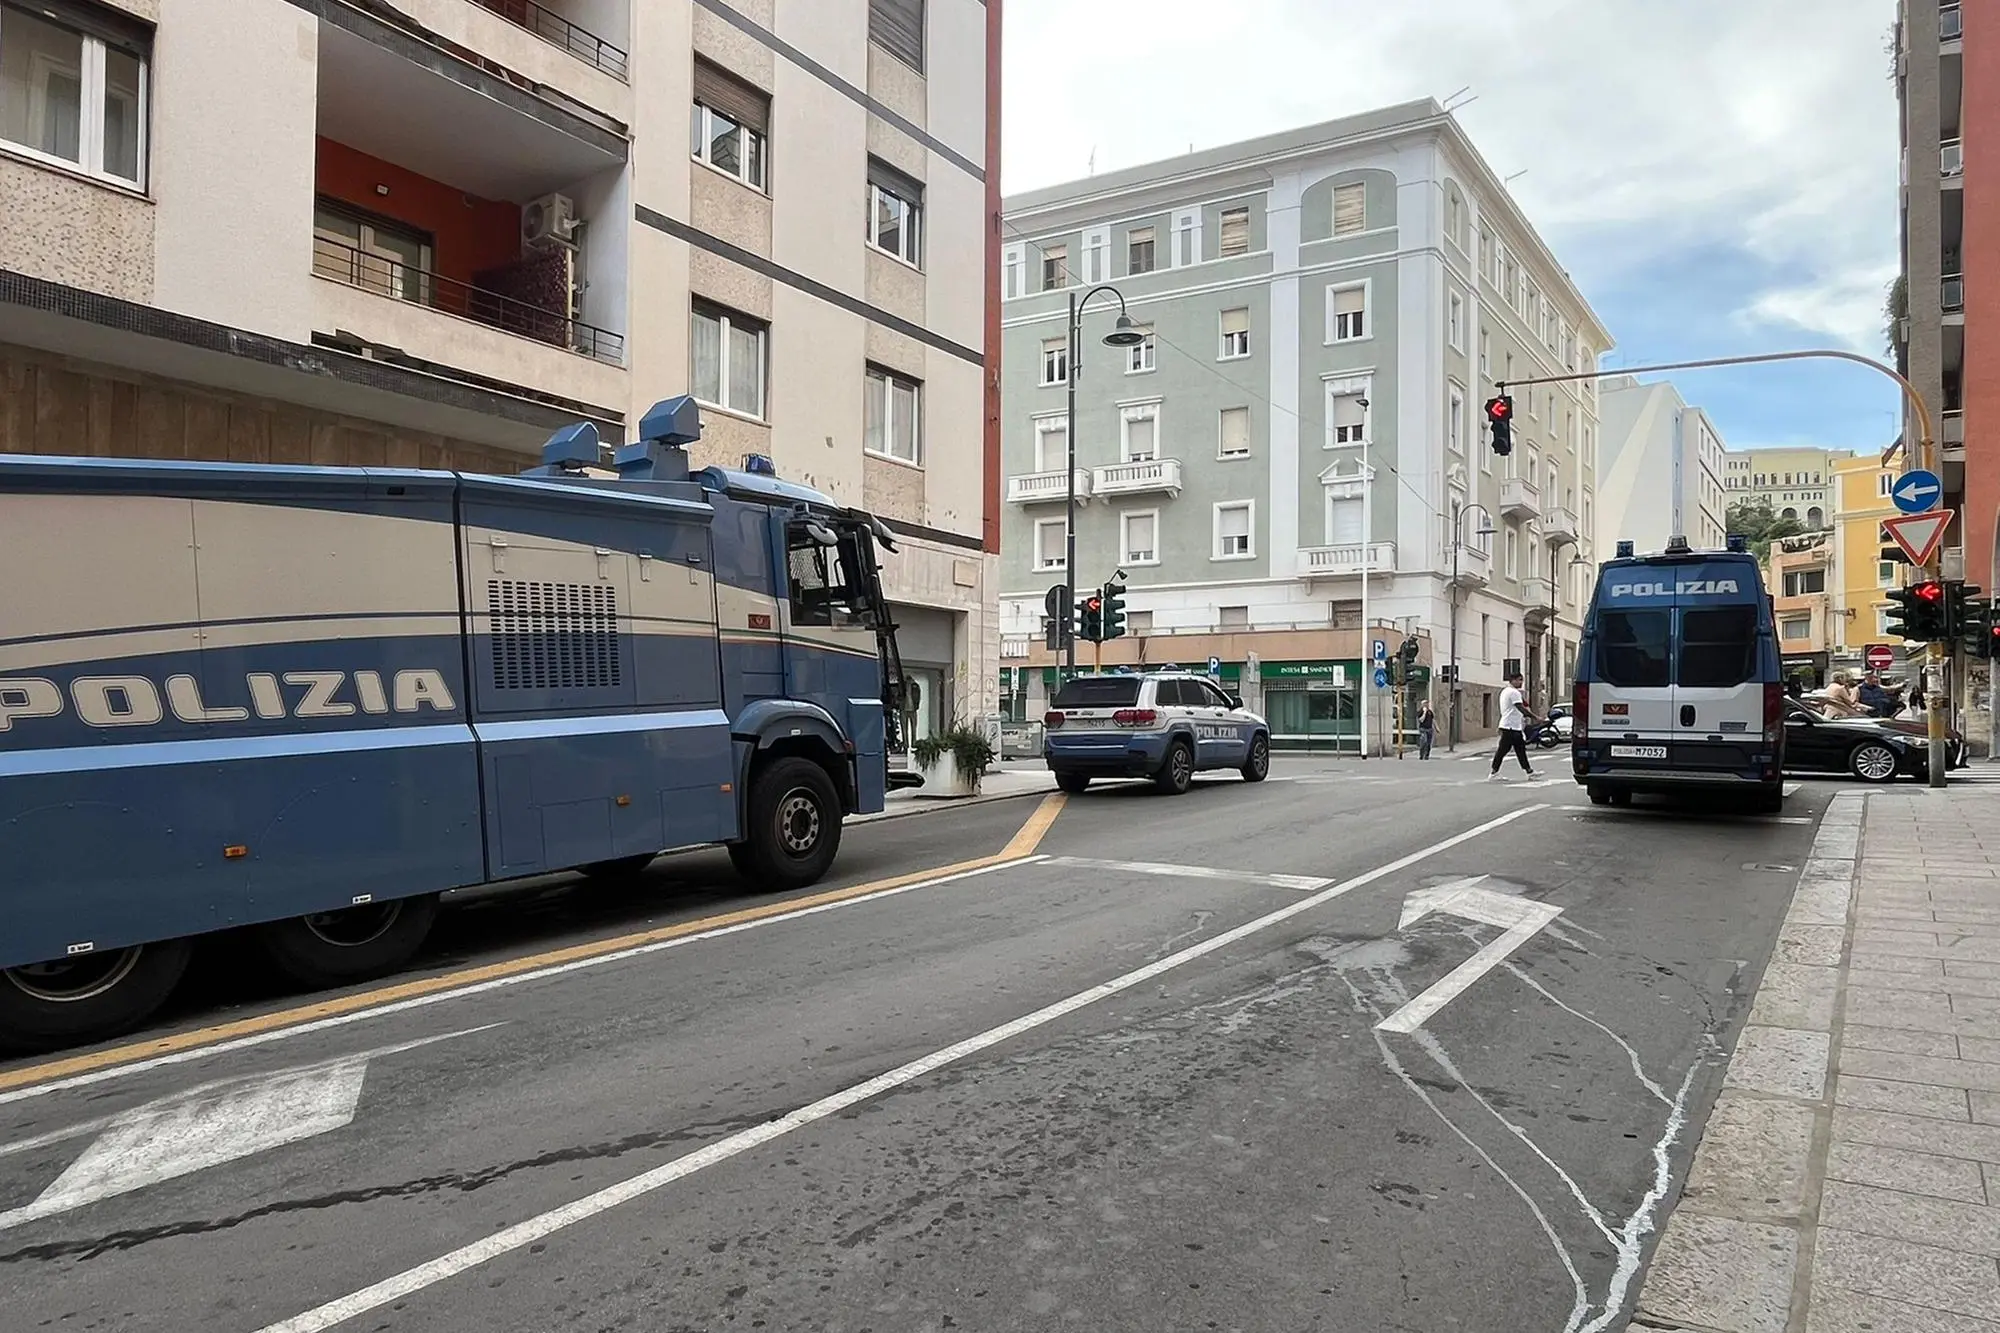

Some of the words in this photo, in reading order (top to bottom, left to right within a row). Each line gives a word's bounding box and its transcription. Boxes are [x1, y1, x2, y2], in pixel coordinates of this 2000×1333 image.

[1612, 580, 1738, 597] POLIZIA
[1375, 641, 1384, 658] P
[1210, 657, 1219, 673] P
[0, 670, 457, 732] POLIZIA
[1196, 726, 1238, 739] POLIZIA
